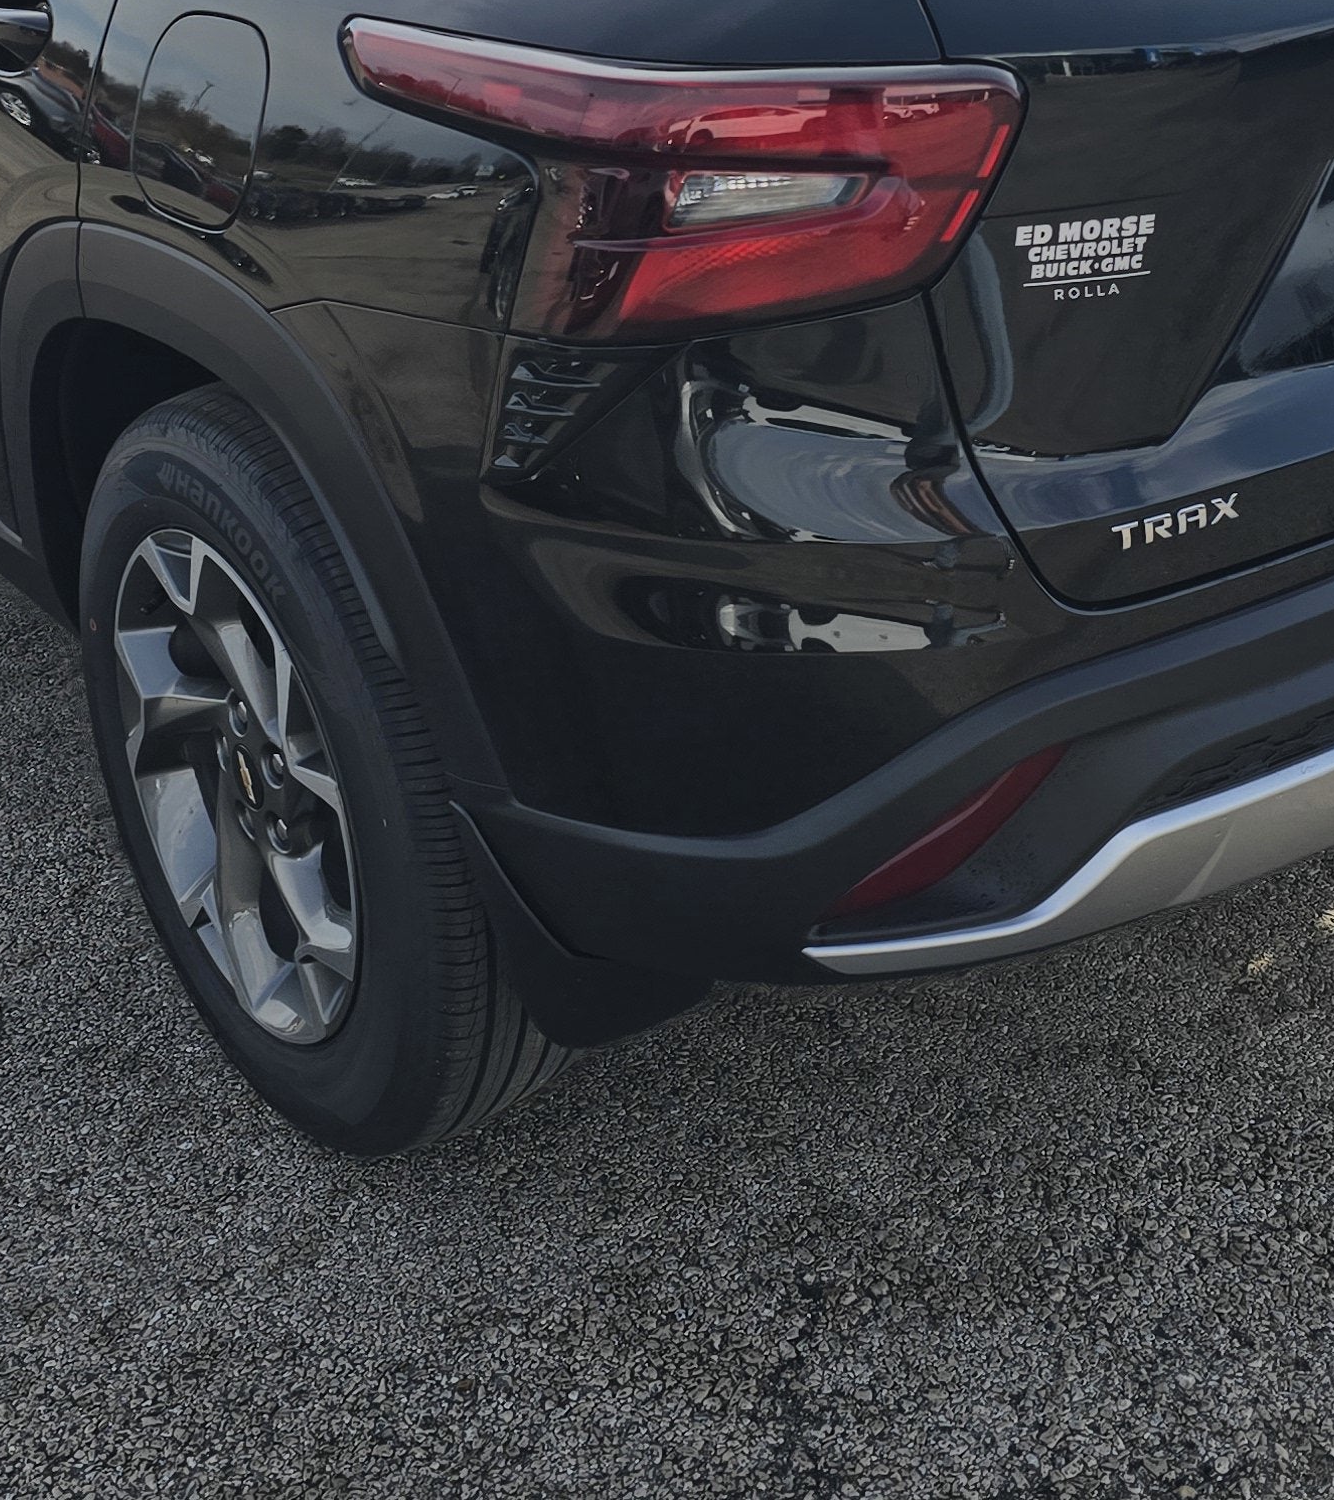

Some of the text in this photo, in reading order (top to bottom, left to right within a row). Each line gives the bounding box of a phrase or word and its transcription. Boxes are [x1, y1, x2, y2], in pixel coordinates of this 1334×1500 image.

[1014, 213, 1156, 247] ED MORSE
[1027, 236, 1148, 263] CHEVROLET
[1053, 282, 1121, 301] ROLLA
[1111, 492, 1240, 550] TRAX
